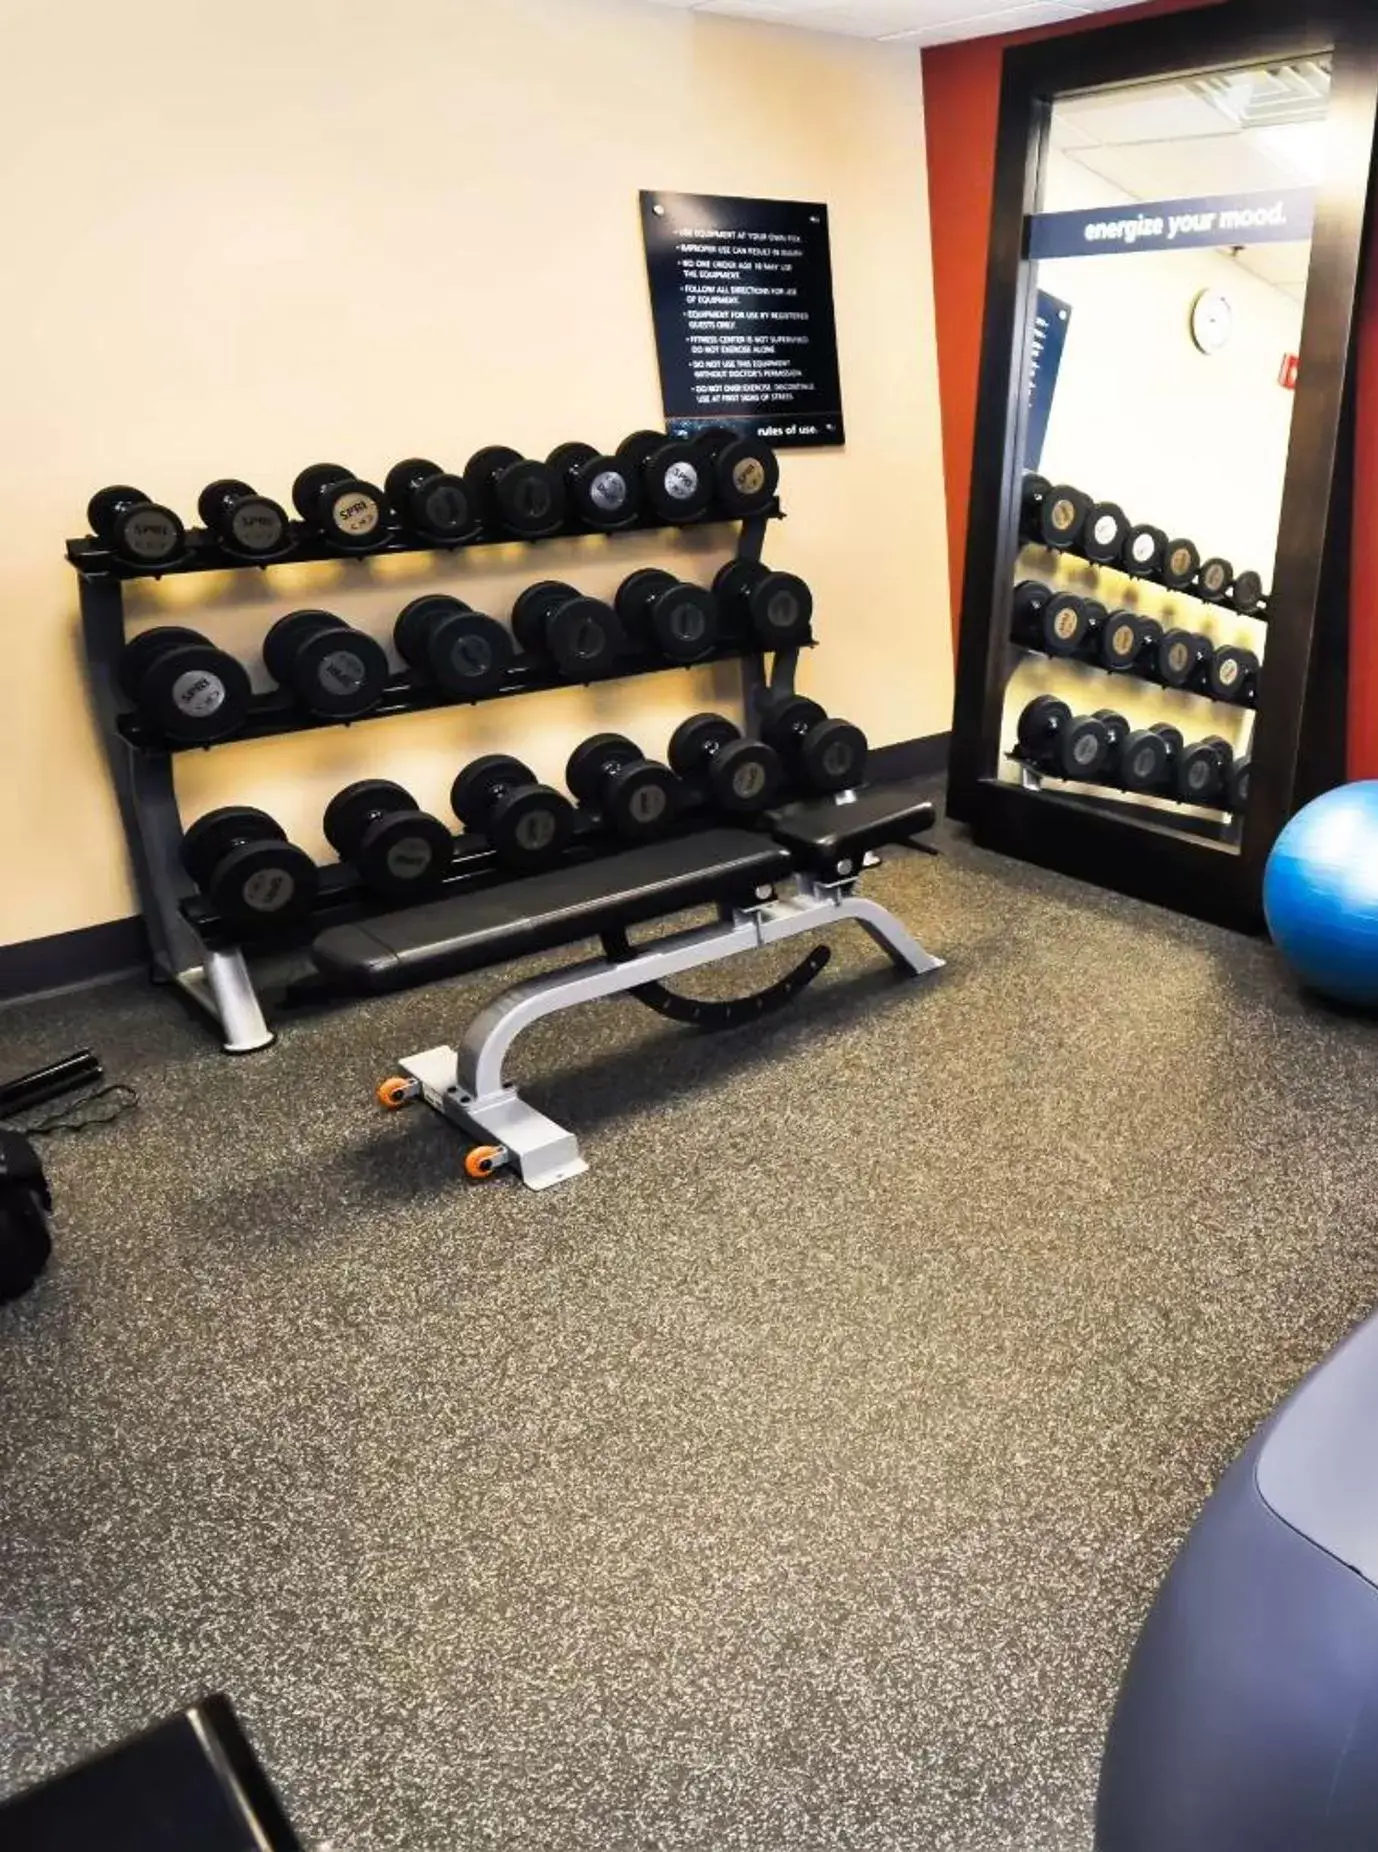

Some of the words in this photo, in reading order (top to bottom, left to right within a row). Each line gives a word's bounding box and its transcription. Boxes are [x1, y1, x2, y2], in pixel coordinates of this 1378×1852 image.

[1083, 213, 1164, 244] energize
[1166, 210, 1218, 240] your
[1218, 201, 1288, 229] mood.
[756, 425, 784, 437] rules
[785, 424, 797, 436] of
[339, 499, 368, 521] SPRI
